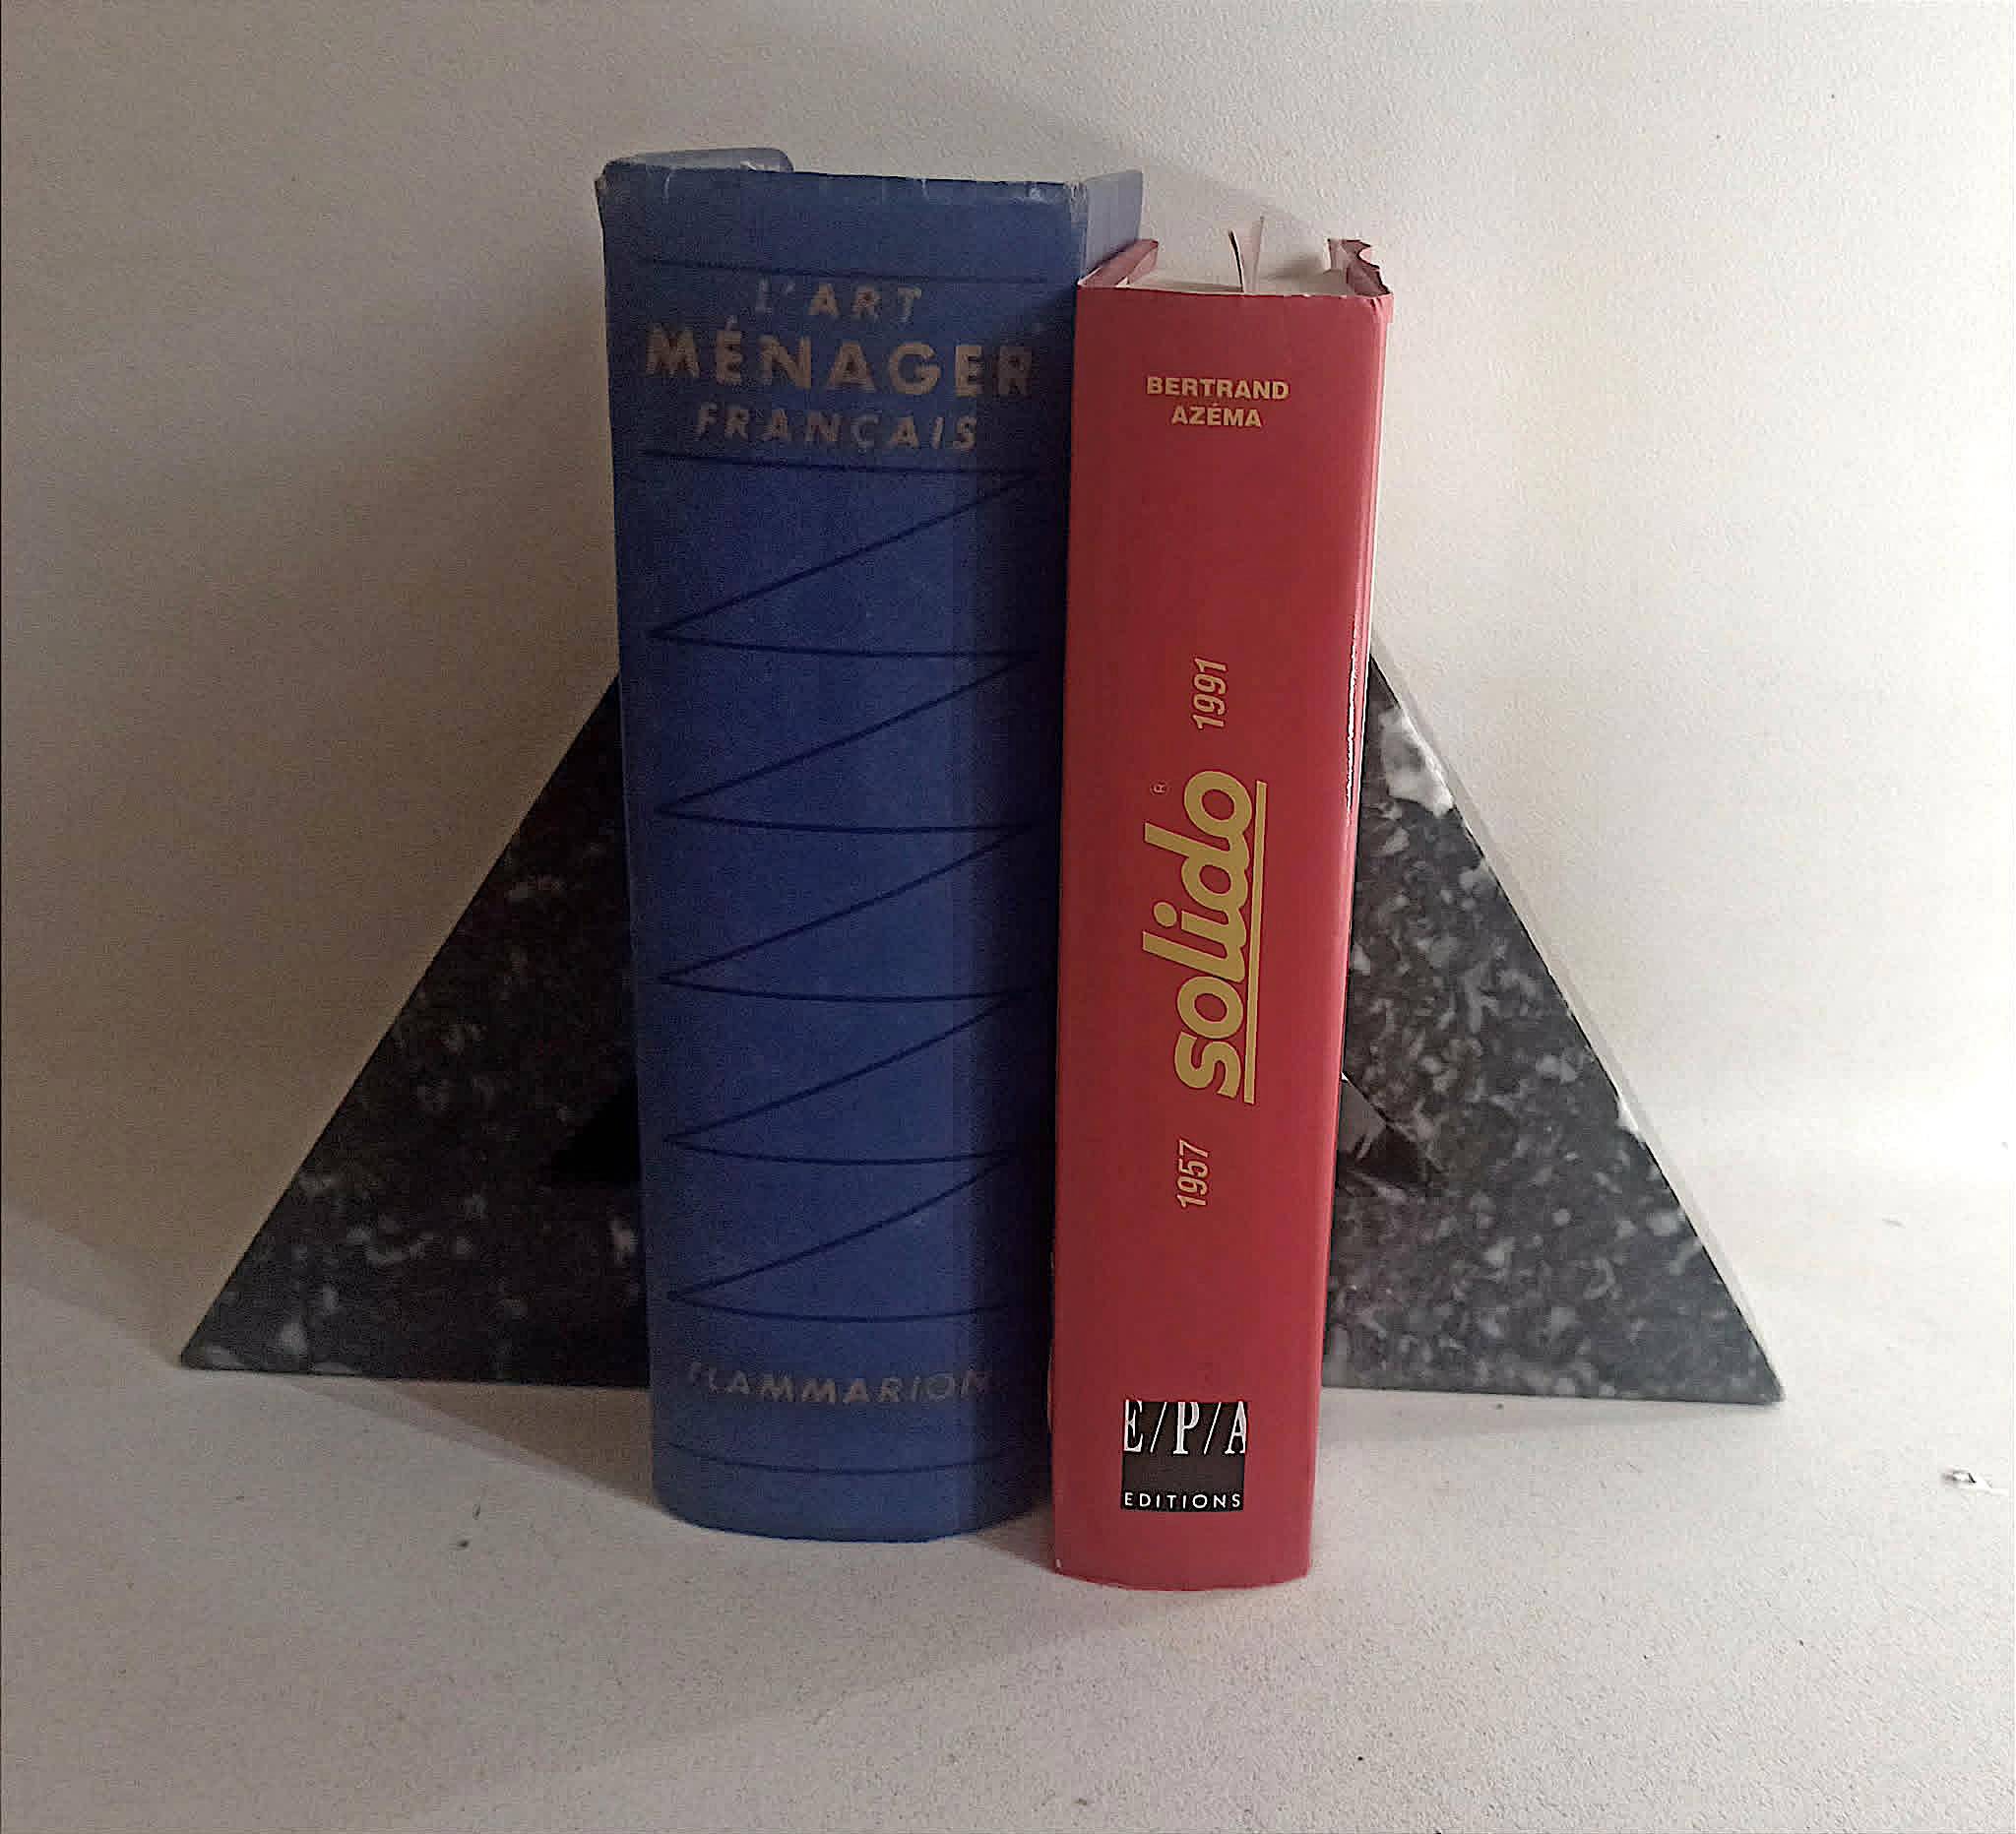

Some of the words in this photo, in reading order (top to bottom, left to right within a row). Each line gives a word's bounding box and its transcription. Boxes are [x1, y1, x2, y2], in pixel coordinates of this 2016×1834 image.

[645, 315, 1034, 397] MÉNAGER
[1146, 376, 1289, 400] BERTRAND
[1171, 403, 1263, 427] AZÉMA
[694, 401, 979, 452] FRANÇAIS
[1192, 658, 1228, 729] 1991
[1142, 770, 1254, 1099] solido
[1176, 1139, 1209, 1208] 1957
[1124, 1491, 1241, 1509] EDITIONS
